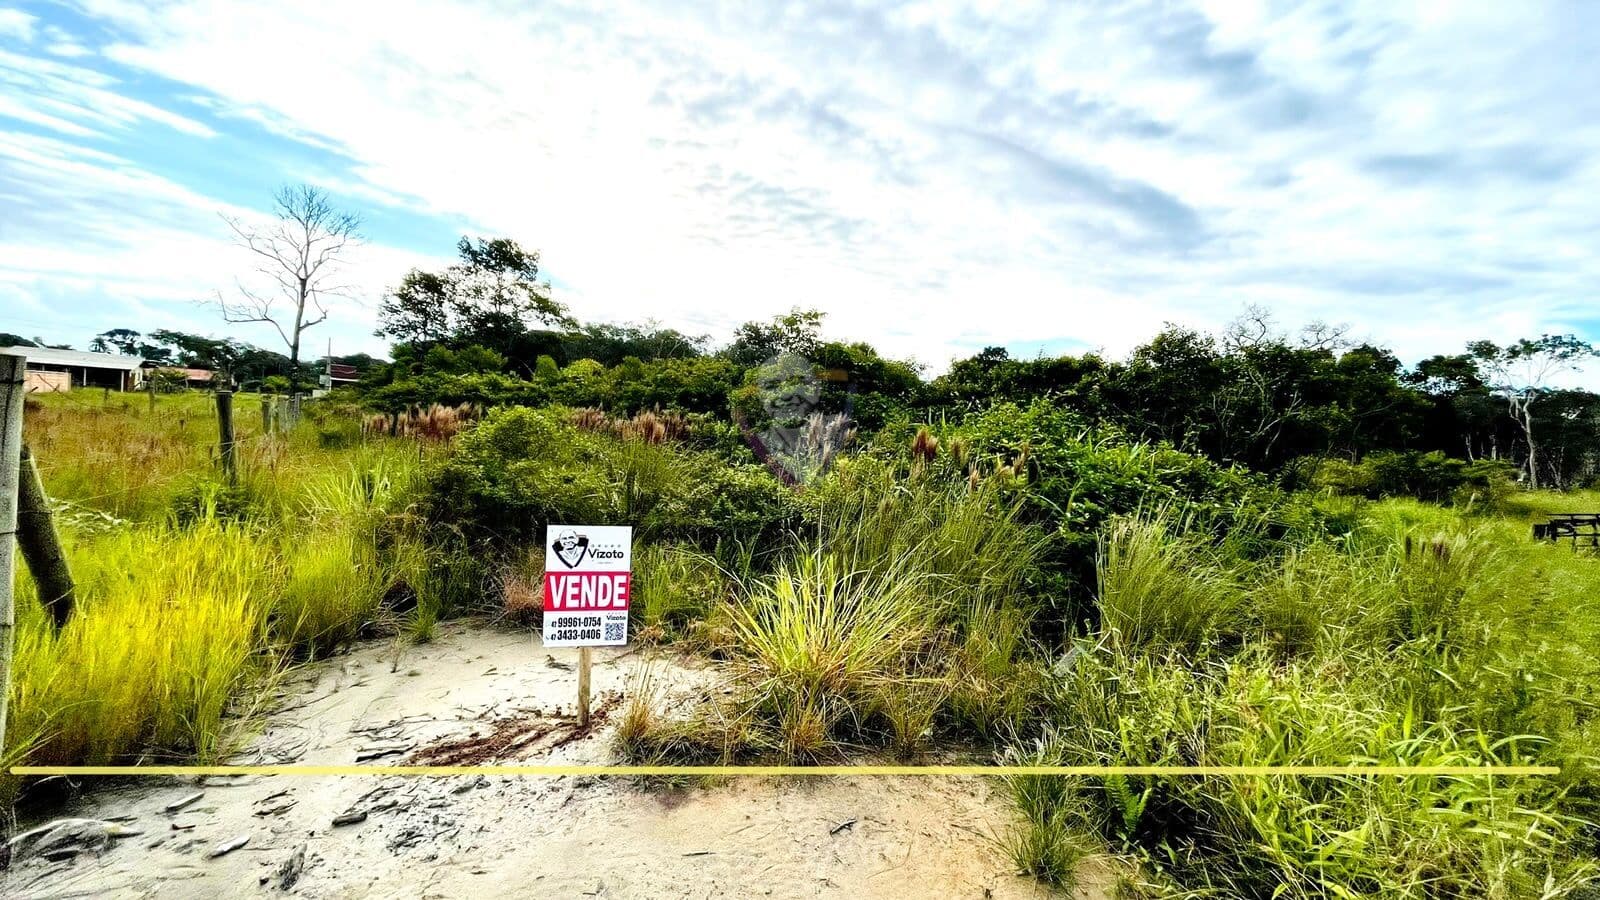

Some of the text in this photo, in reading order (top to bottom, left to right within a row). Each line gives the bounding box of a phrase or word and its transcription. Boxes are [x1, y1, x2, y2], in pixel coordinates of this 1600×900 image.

[588, 548, 624, 559] Vizoto
[549, 575, 627, 609] VENDE
[558, 617, 601, 628] 99961-0754
[557, 629, 601, 640] 3433-0406
